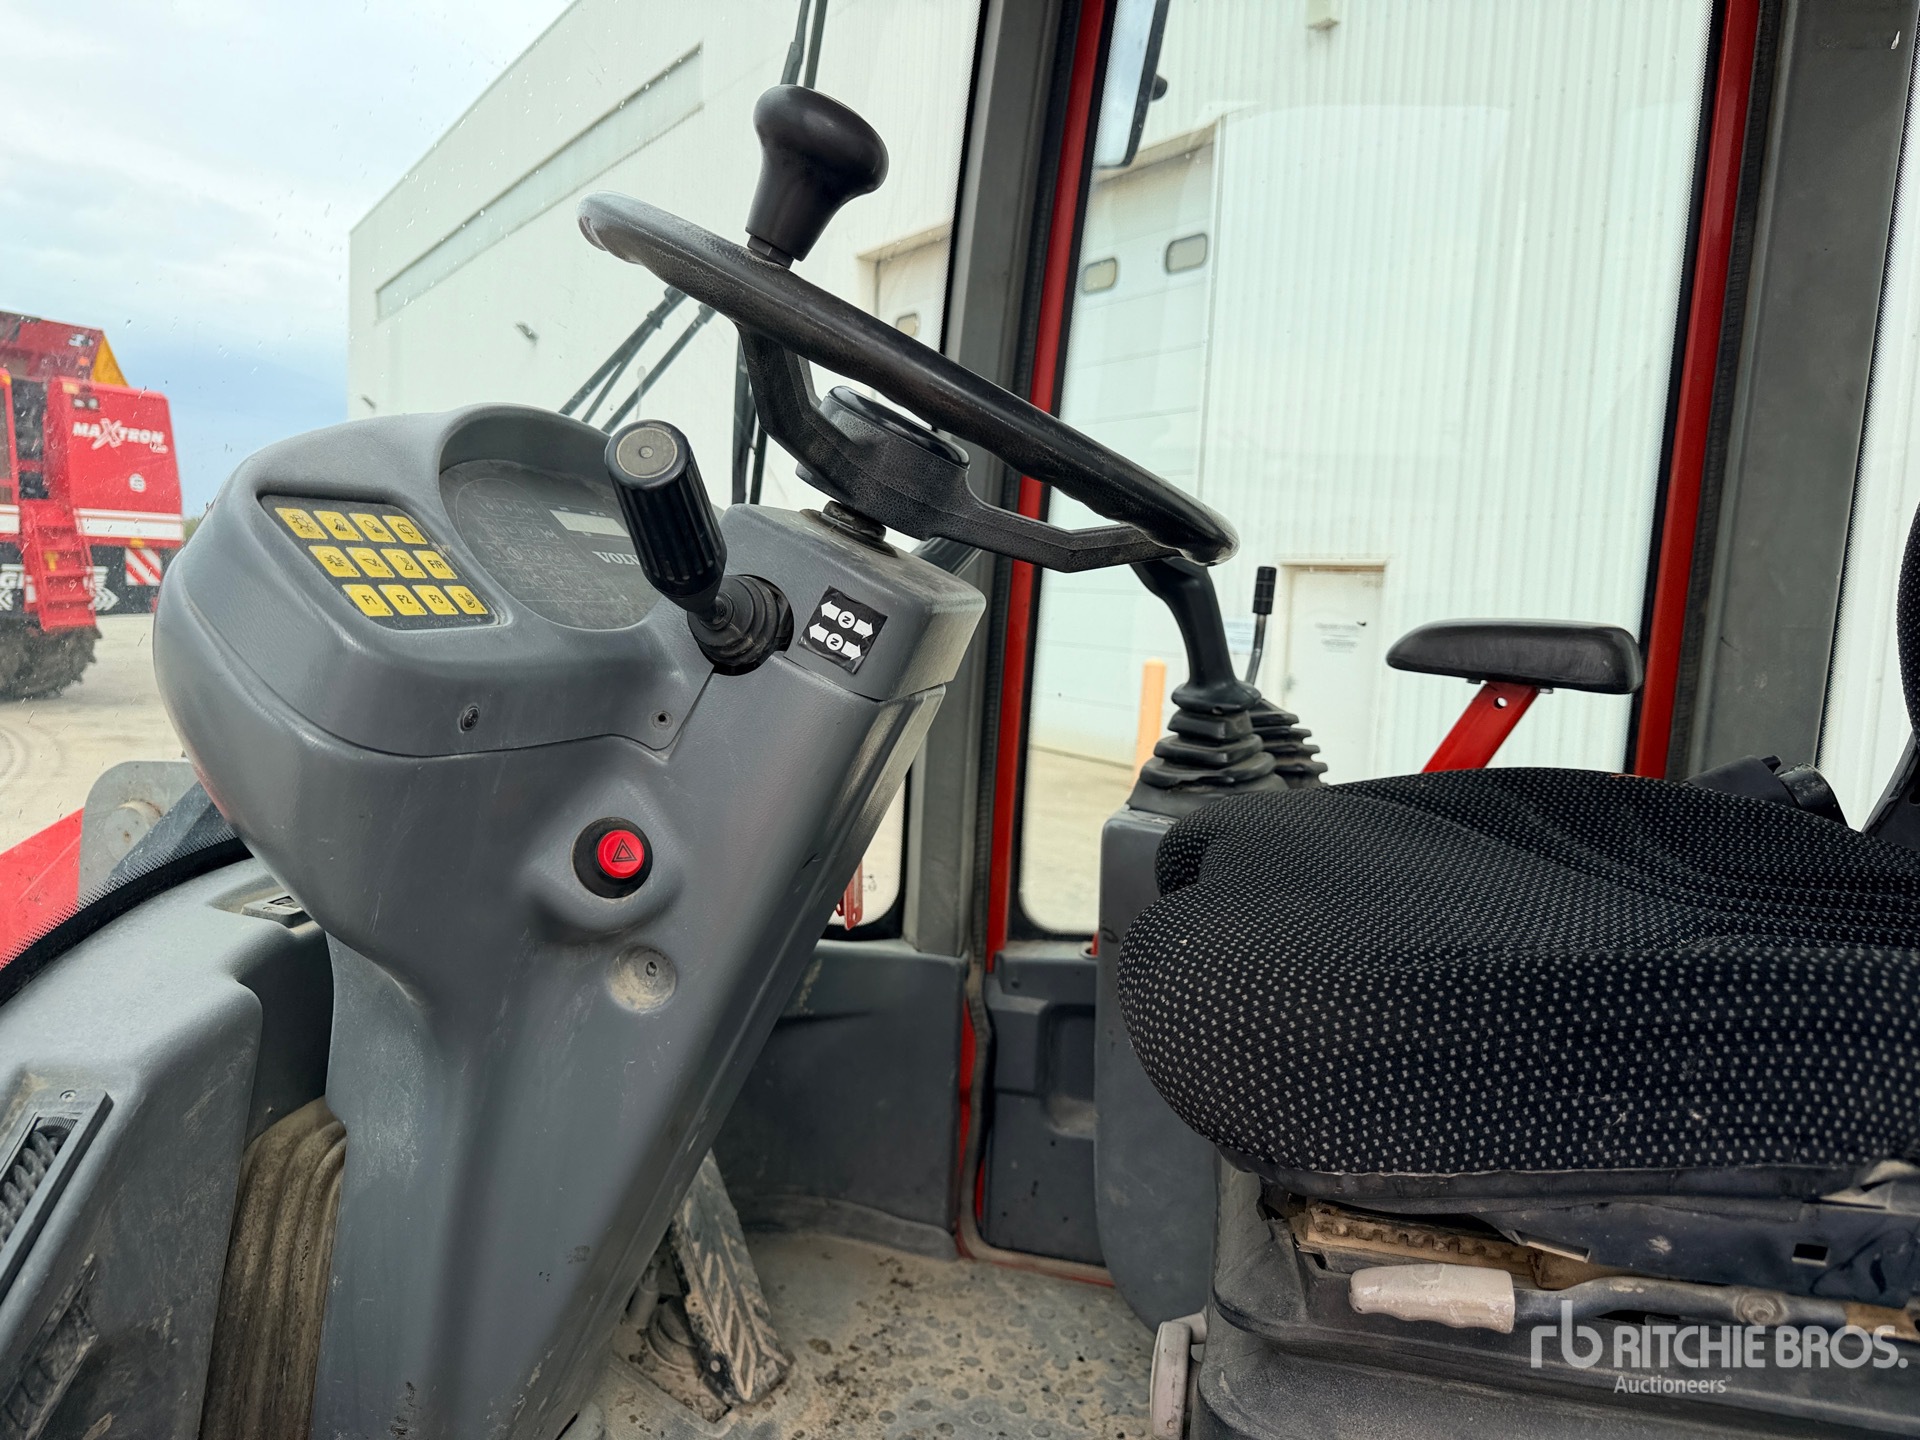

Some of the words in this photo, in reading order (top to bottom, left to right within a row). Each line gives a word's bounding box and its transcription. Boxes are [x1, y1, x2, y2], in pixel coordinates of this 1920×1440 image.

[73, 418, 165, 450] MAXTRON
[592, 550, 641, 567] VOLV
[427, 559, 446, 569] F/R
[361, 594, 378, 605] F1
[396, 594, 413, 605] F2
[428, 594, 444, 604] F3
[841, 615, 852, 625] N
[829, 637, 840, 647] N
